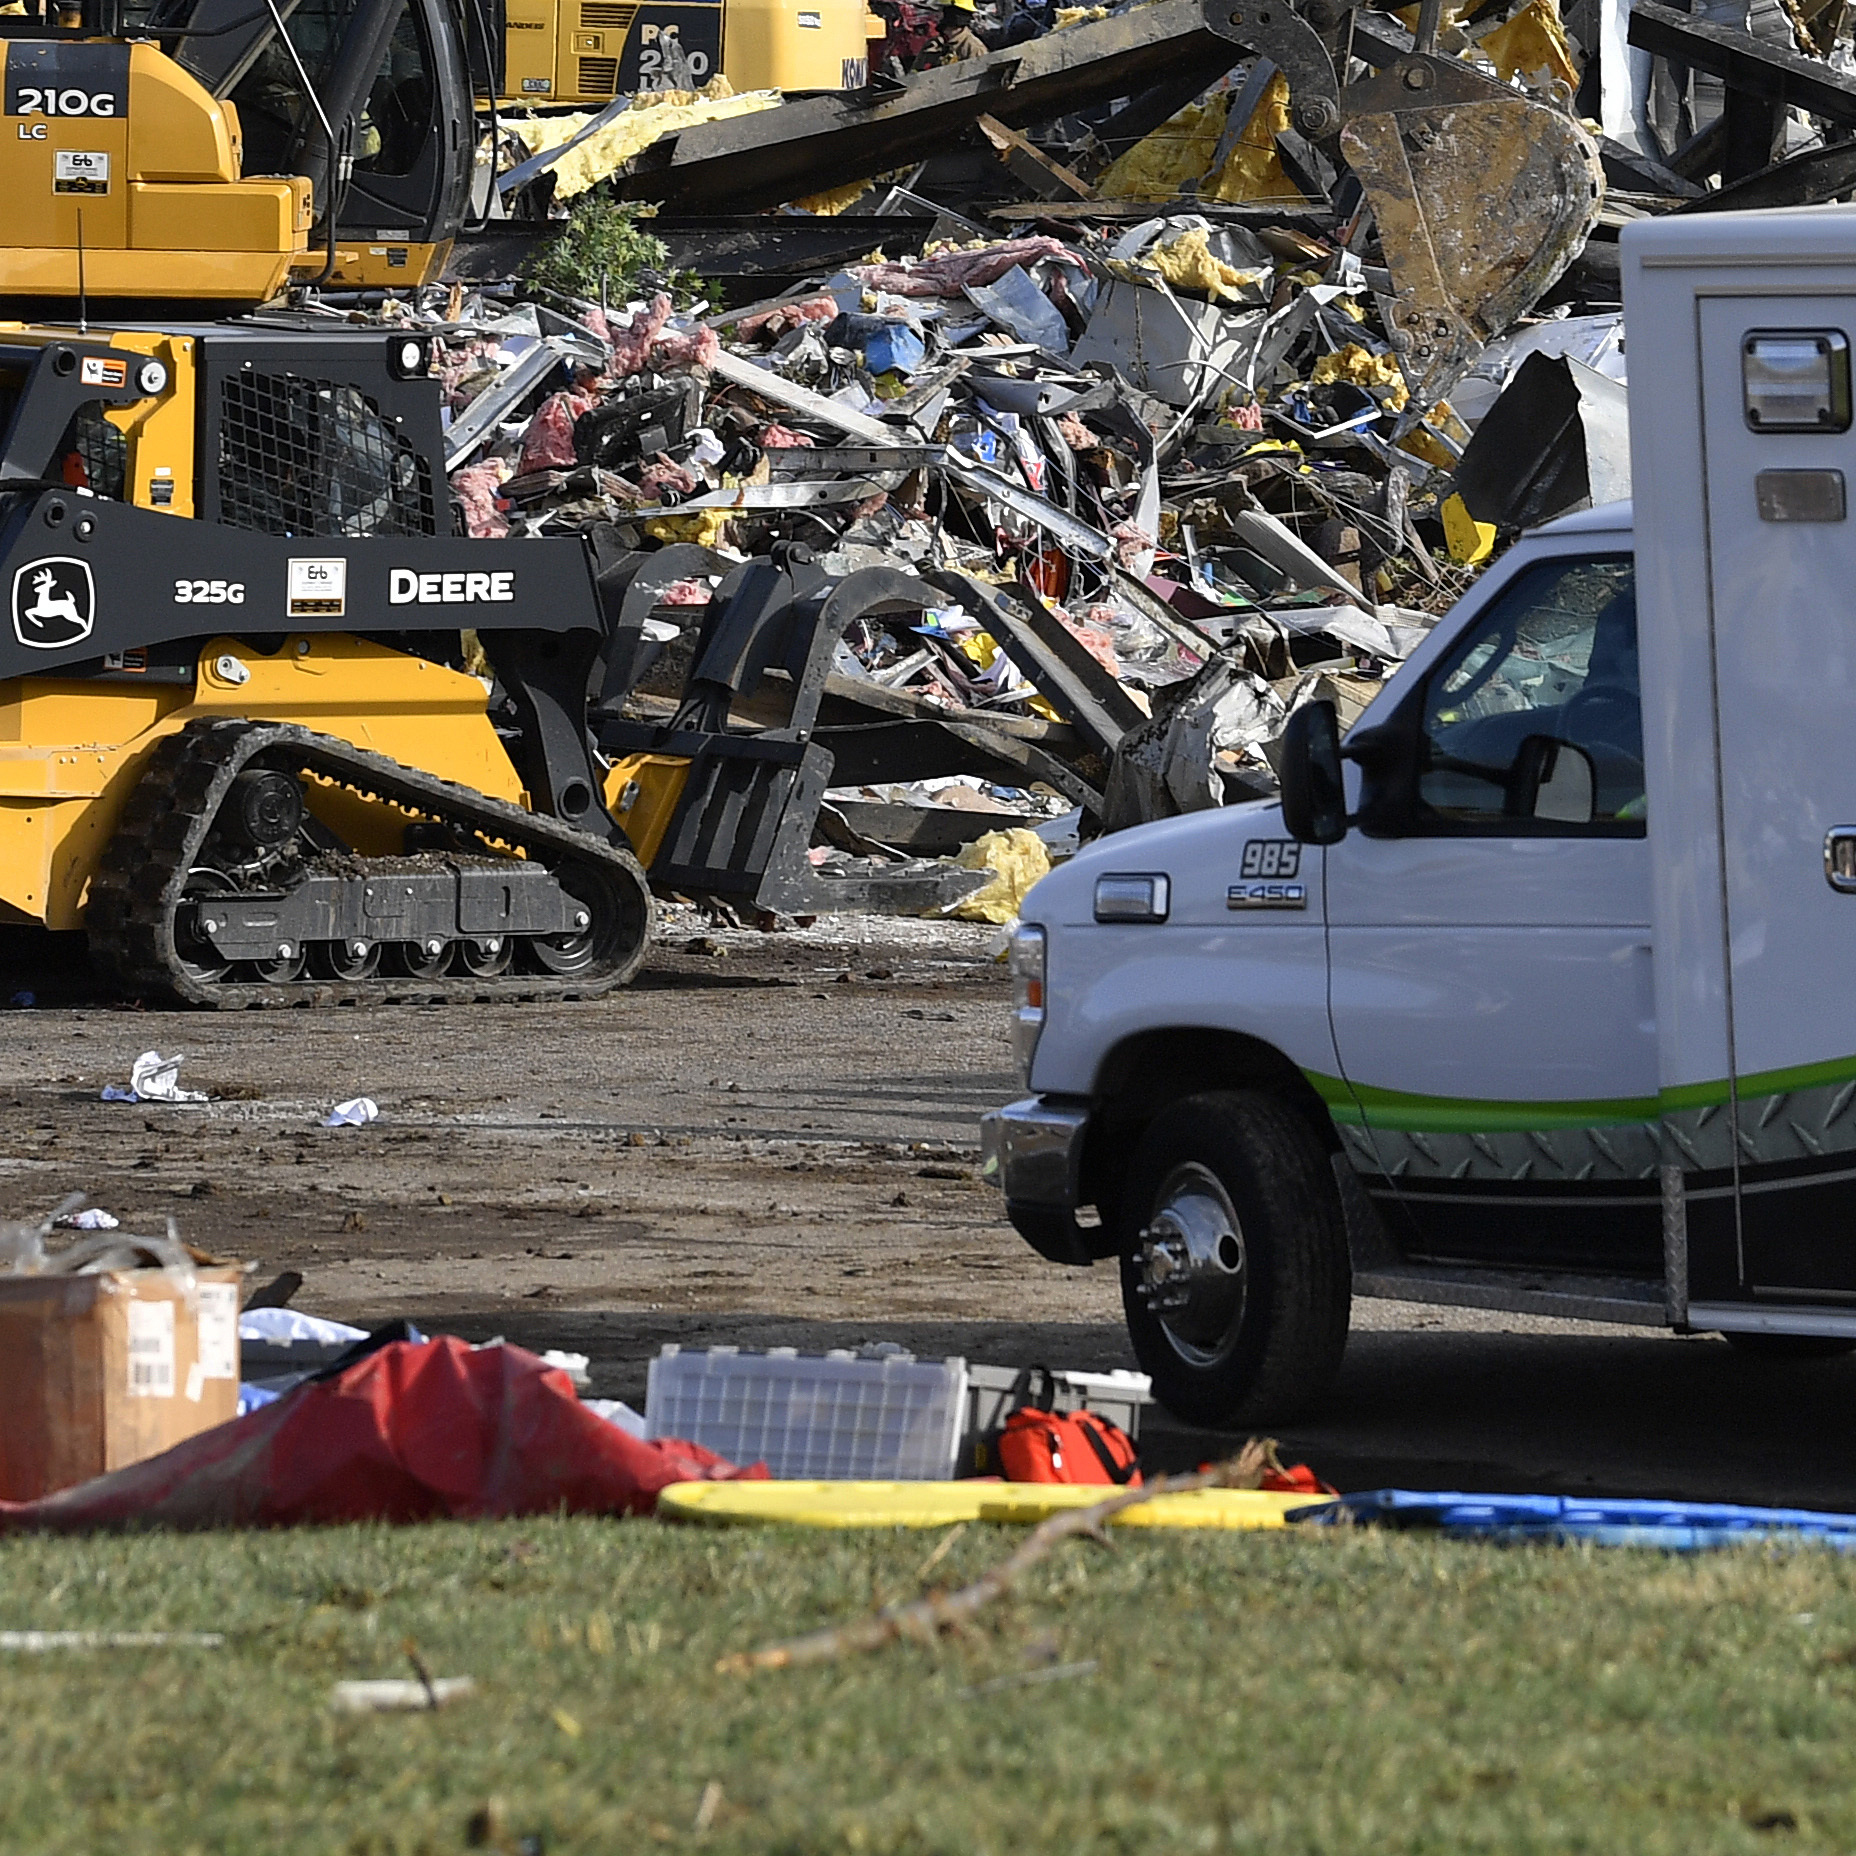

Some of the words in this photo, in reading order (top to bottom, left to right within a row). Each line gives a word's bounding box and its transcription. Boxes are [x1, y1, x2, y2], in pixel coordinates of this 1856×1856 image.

[639, 49, 709, 76] 20
[17, 88, 115, 116] 210G
[18, 124, 48, 139] LC
[71, 154, 93, 167] Erb
[173, 579, 245, 604] 325G
[389, 568, 515, 604] DEERE
[1241, 840, 1301, 878] 985
